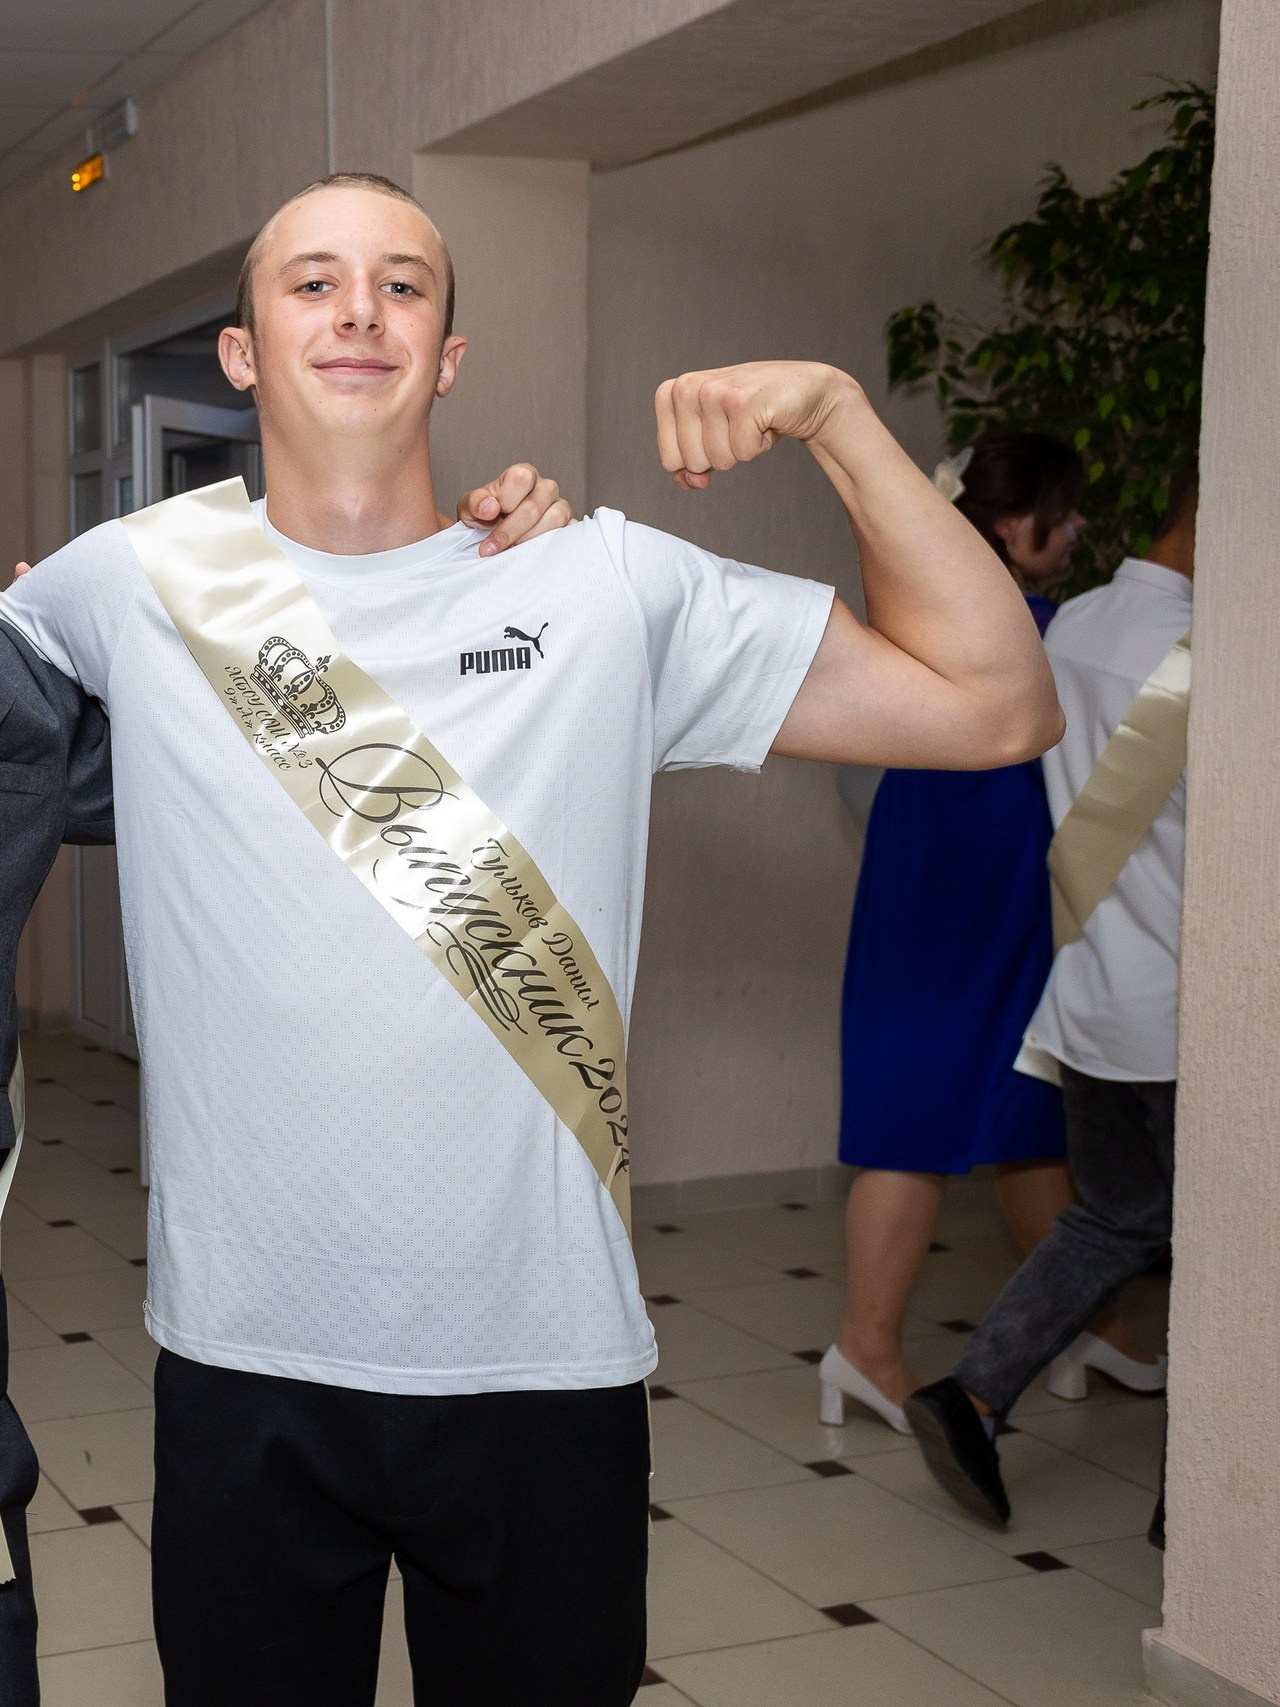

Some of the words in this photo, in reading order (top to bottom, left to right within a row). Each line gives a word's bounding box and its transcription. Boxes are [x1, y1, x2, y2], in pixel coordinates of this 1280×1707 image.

[460, 647, 531, 675] PUMA
[224, 665, 265, 707] МБОУ
[255, 708, 291, 740] СОШ
[252, 732, 291, 772] класс
[541, 931, 600, 1012] Данил
